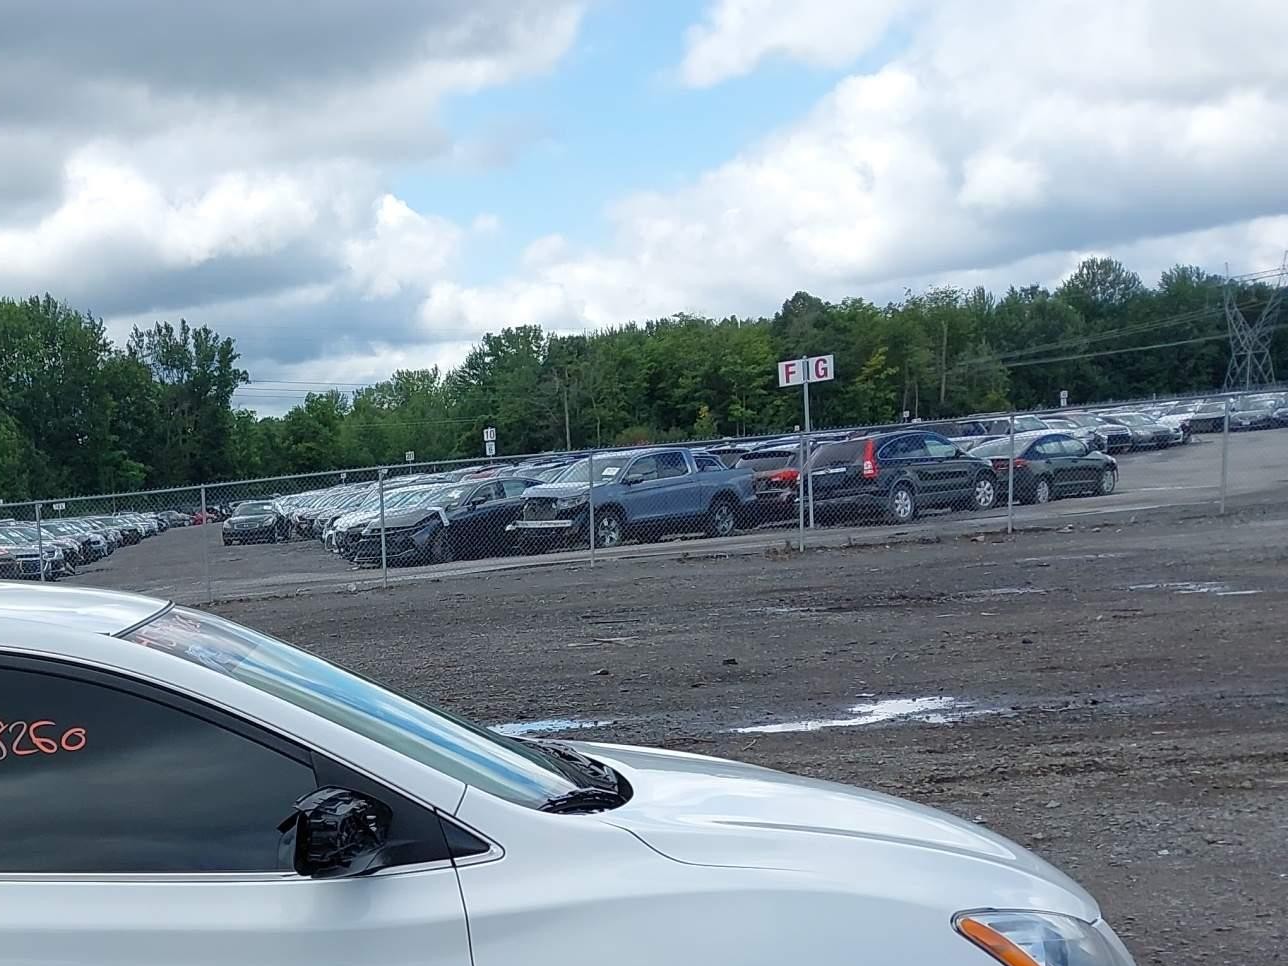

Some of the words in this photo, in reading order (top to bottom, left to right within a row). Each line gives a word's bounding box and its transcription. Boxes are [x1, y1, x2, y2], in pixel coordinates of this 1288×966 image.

[785, 363, 796, 384] F
[815, 358, 828, 379] G
[485, 429, 495, 440] 10
